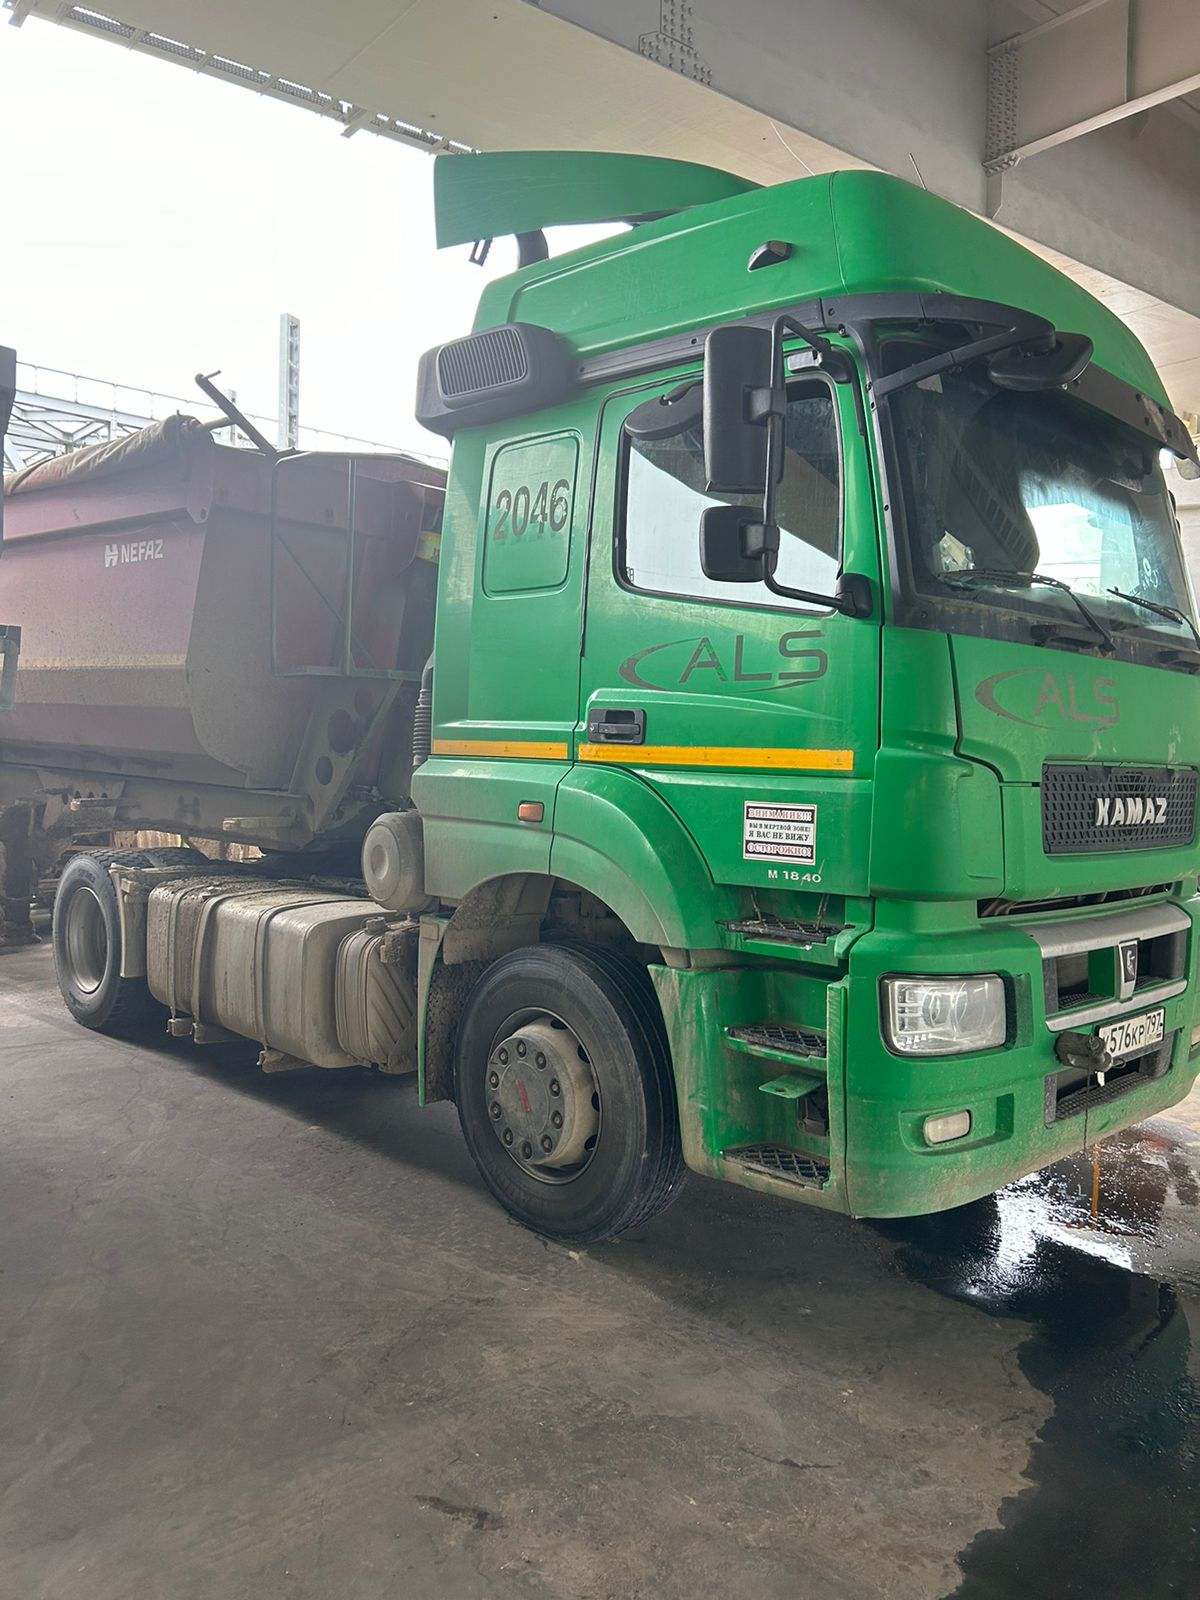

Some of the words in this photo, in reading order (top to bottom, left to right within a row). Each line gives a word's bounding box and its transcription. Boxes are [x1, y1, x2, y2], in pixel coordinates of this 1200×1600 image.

[493, 479, 570, 541] 2046
[121, 539, 163, 563] NEFAZ
[679, 630, 828, 684] ALS
[1035, 671, 1119, 724] ALS
[1095, 797, 1168, 827] KAMAZ
[748, 830, 754, 838] Я
[756, 830, 771, 839] ВАС
[773, 831, 784, 840] НЕ
[785, 833, 810, 842] ВИЖУ
[747, 842, 812, 857] ОСТОРОЖНО!
[783, 870, 822, 883] 1840
[1146, 1012, 1162, 1035] 797
